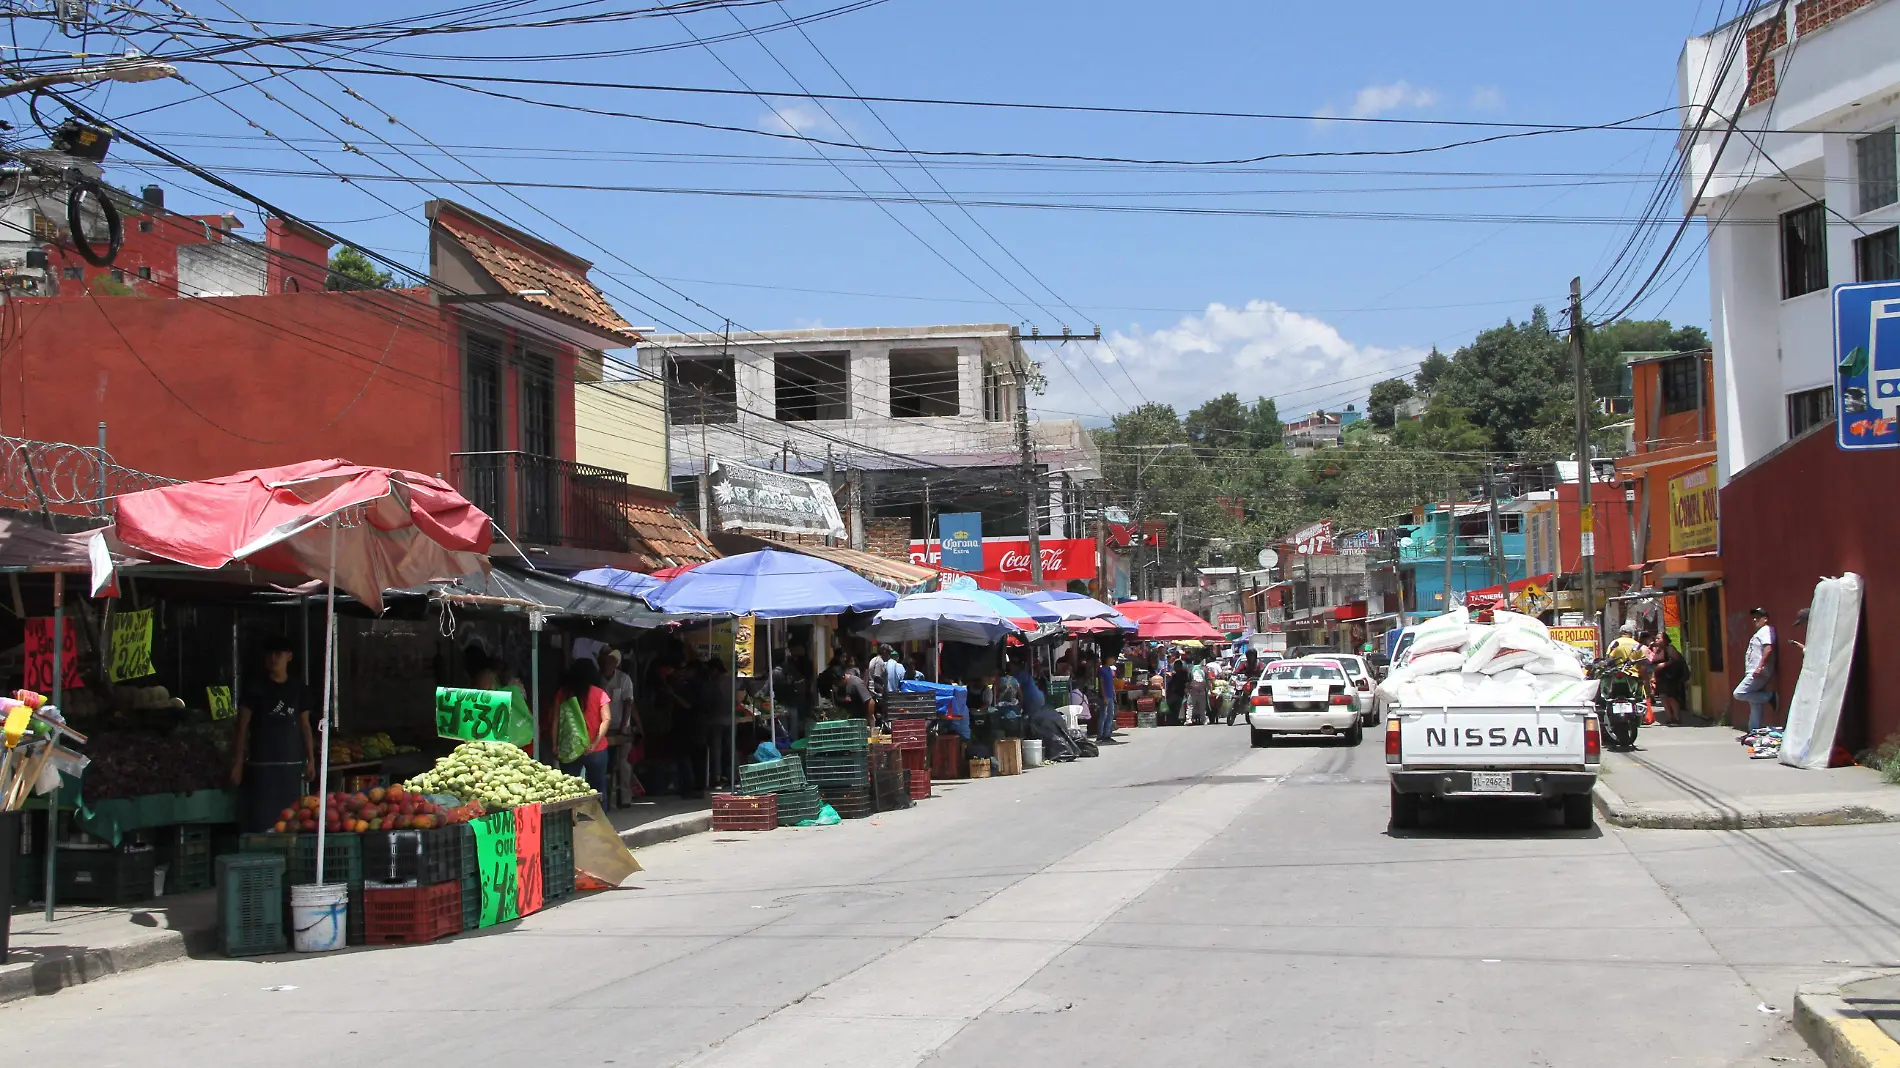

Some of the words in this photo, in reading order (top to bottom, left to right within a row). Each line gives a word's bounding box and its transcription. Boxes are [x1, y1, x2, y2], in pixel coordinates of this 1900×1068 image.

[942, 538, 980, 550] Corona
[1000, 548, 1065, 573] CocaCola
[1550, 630, 1564, 641] BIG
[1565, 629, 1594, 641] POLLOS
[1426, 727, 1558, 747] NISSAN
[1473, 777, 1511, 787] XL-2462-A
